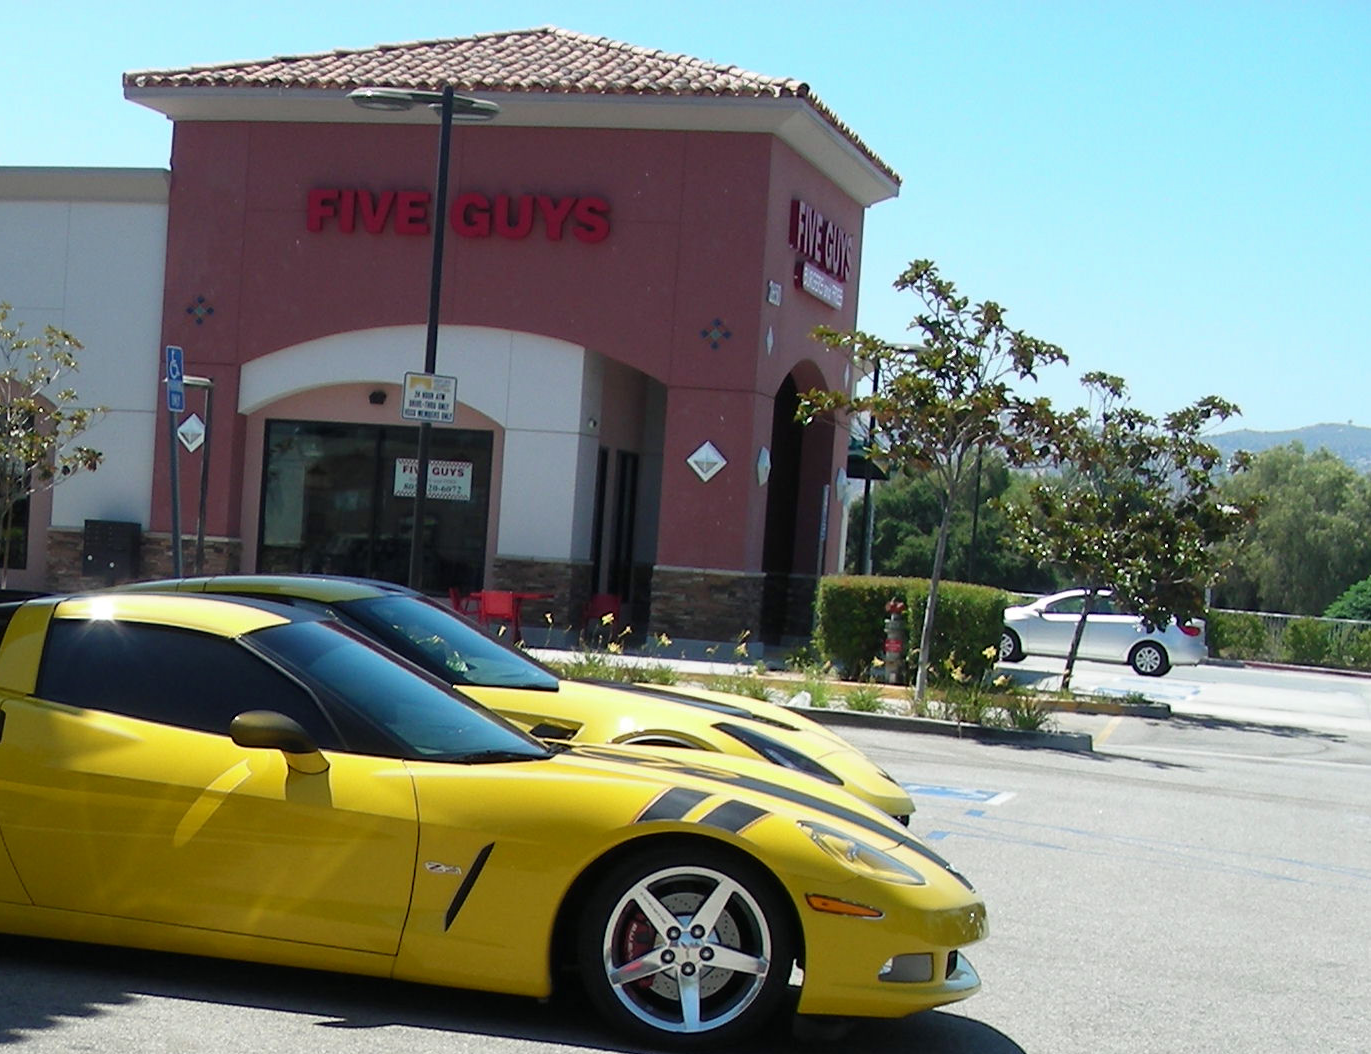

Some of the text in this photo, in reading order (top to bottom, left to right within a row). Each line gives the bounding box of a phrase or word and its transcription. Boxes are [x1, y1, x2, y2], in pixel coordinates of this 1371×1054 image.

[306, 188, 612, 243] FIVE GUYS
[795, 200, 853, 281] FIVE GUYS
[432, 467, 464, 477] GUYS
